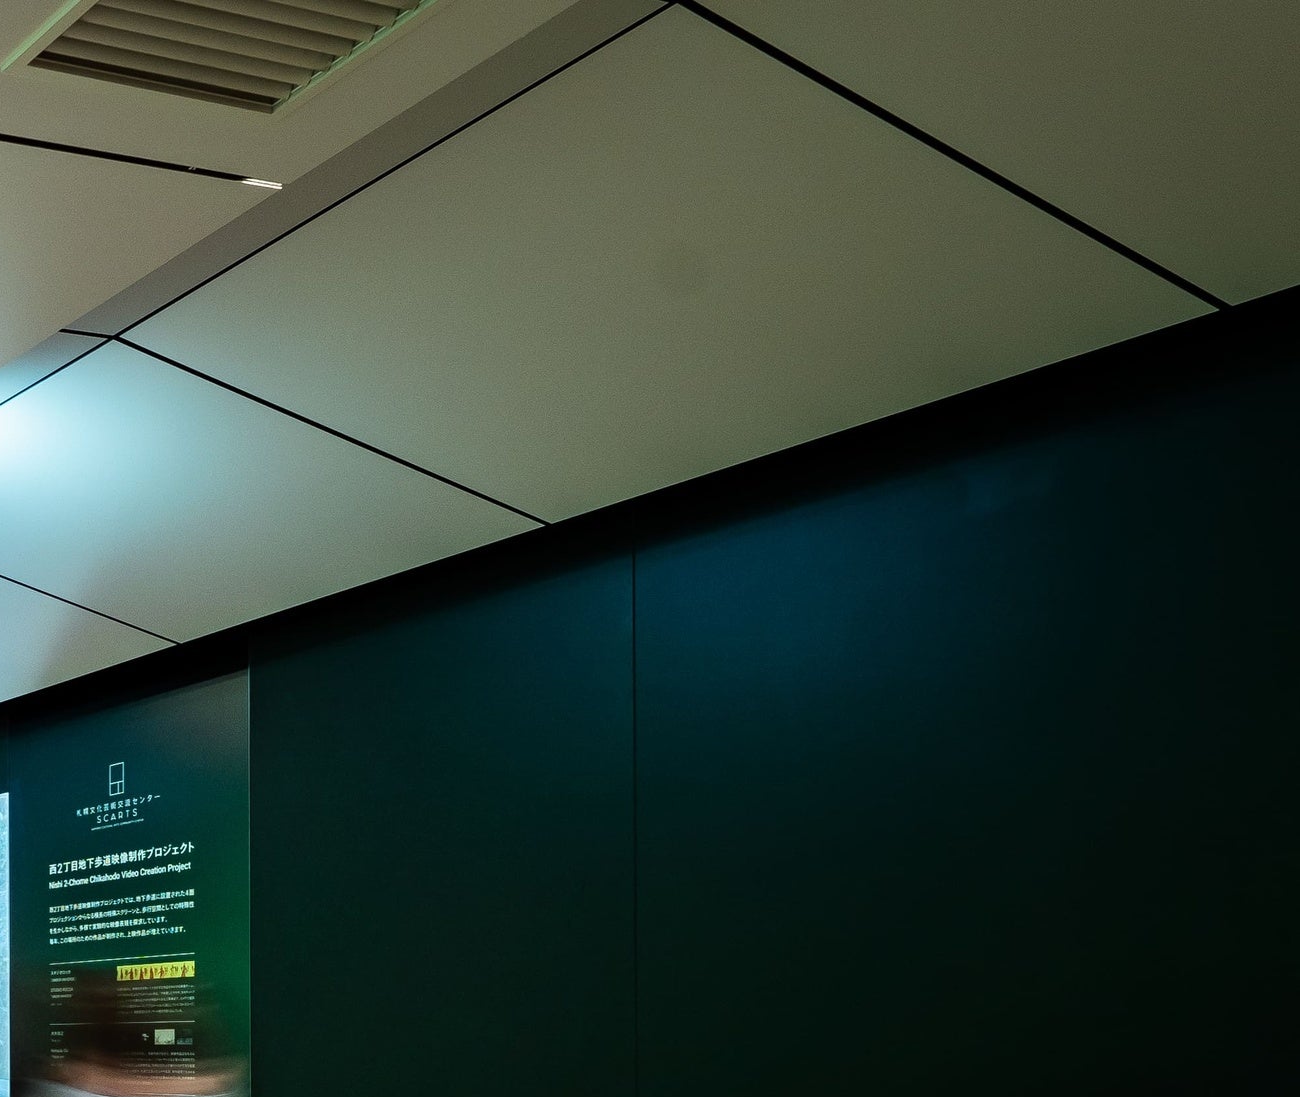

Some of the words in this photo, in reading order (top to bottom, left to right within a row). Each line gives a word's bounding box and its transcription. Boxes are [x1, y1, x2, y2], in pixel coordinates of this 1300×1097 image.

[76, 794, 161, 817] 札幌文化芸術交流センター
[96, 808, 138, 824] SCARTS
[48, 841, 195, 875] 西2丁目地下歩道映像制作プロジェクト
[48, 879, 63, 890] Nishi
[63, 876, 89, 888] 2-Chome
[89, 871, 120, 884] Chikahodo
[121, 868, 139, 879] Video
[140, 864, 166, 877] Creation
[167, 861, 192, 874] Project
